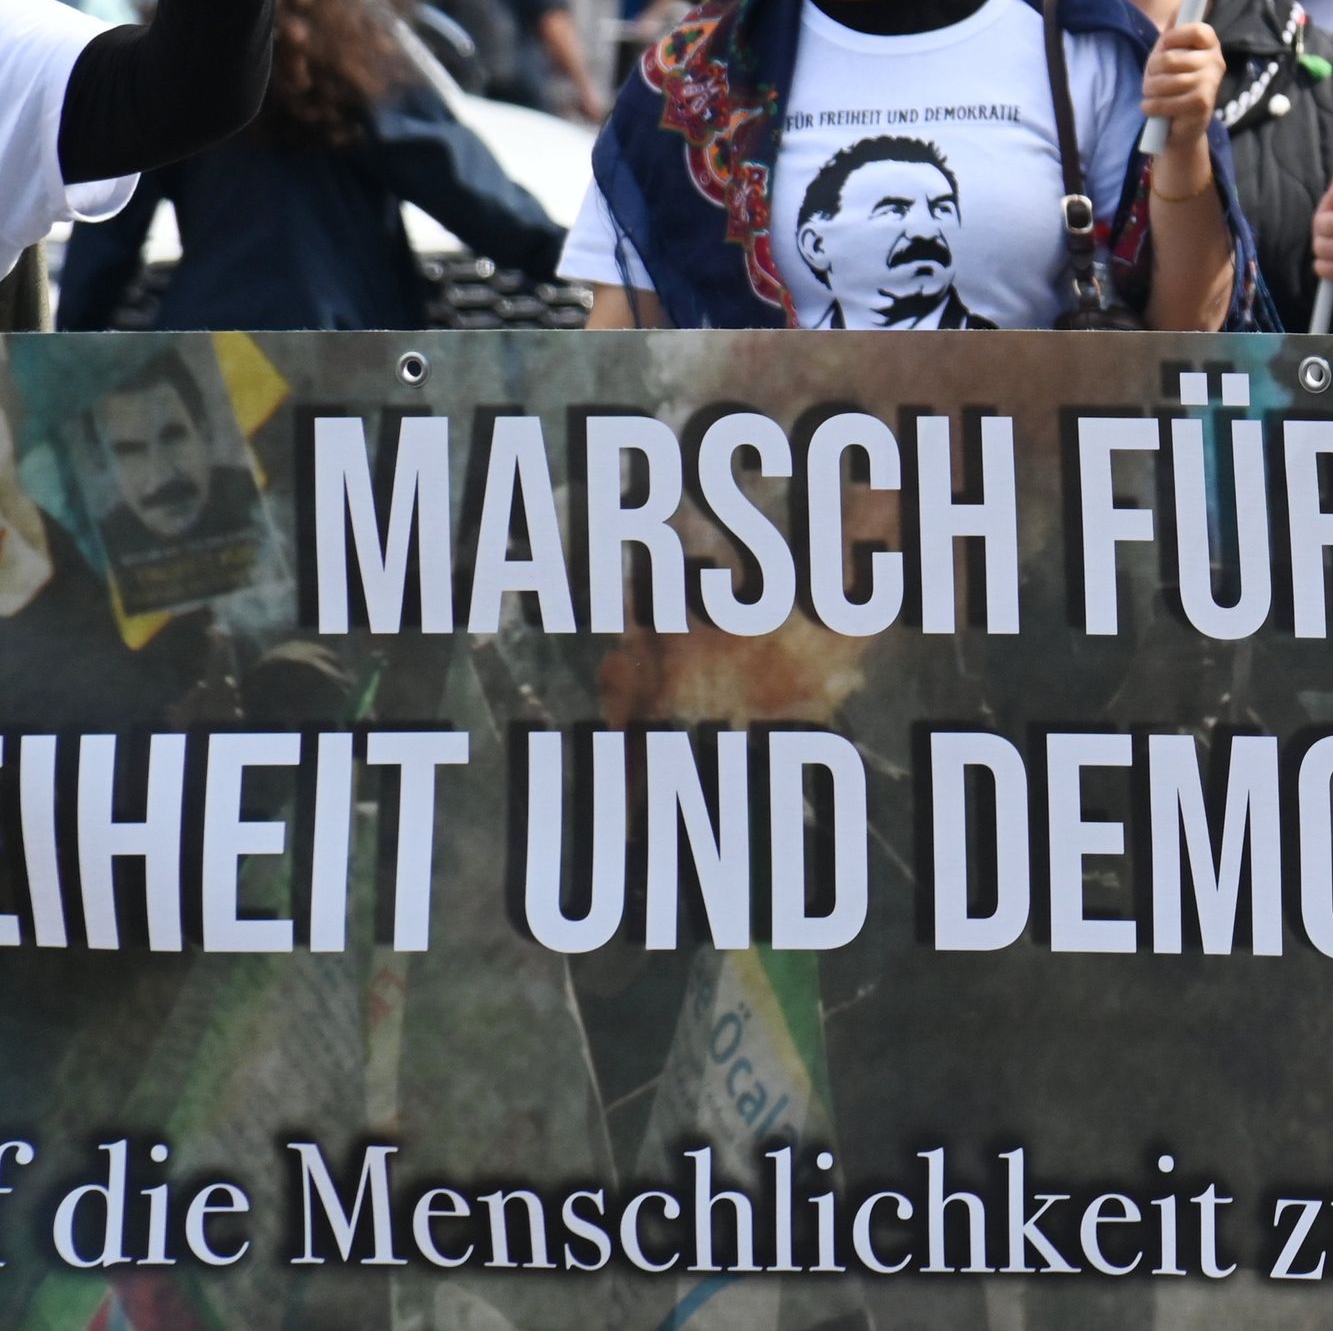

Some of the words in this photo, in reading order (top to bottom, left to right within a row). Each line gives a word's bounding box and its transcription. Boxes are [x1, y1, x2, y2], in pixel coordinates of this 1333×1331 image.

[819, 108, 882, 127] FREIHEIT
[887, 108, 919, 125] UND
[924, 104, 1021, 122] DEMOKRATIE
[313, 412, 1020, 637] MARSCH
[0, 731, 469, 953] IHEIT
[524, 731, 869, 954] UND
[53, 1139, 250, 1268] die
[290, 1142, 1237, 1276] Menschlichkeit
